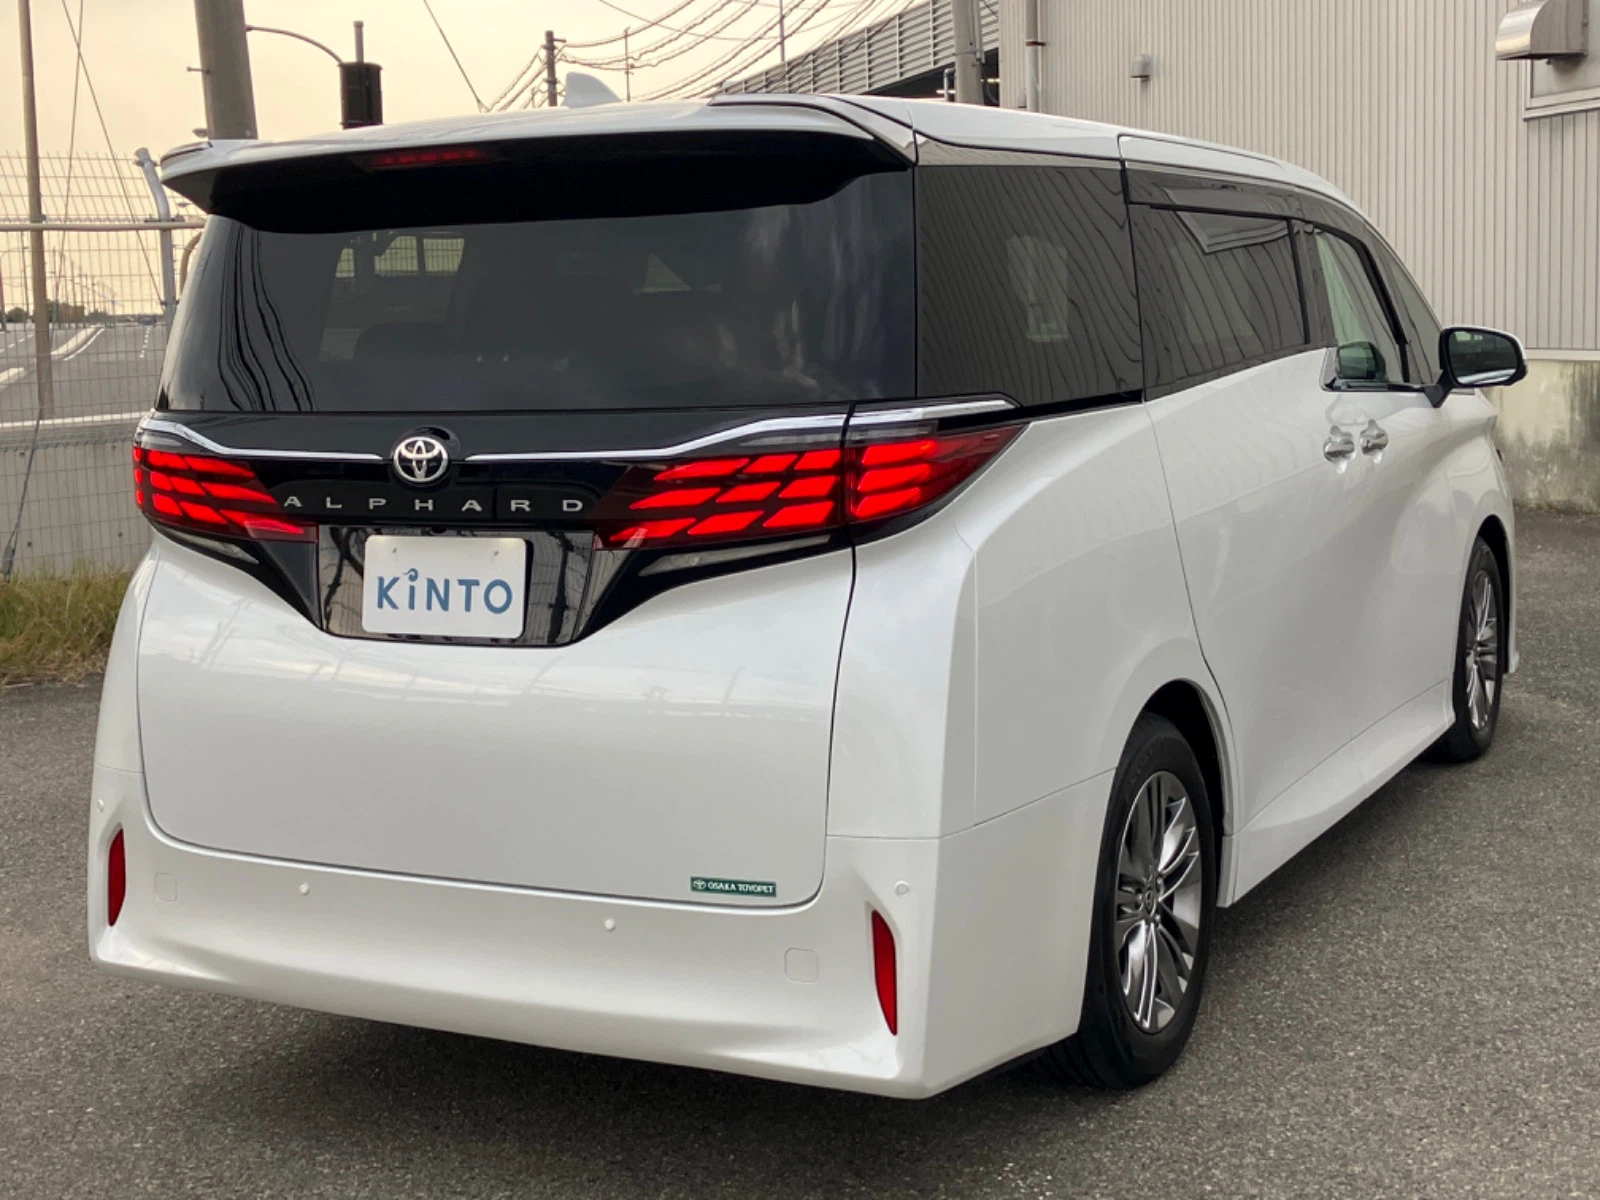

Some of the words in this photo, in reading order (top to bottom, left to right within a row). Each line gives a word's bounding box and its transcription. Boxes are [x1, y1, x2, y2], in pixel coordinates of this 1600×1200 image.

[284, 496, 583, 512] ALPHARD
[707, 881, 737, 891] OSAKA
[737, 883, 774, 893] TOYOPET
